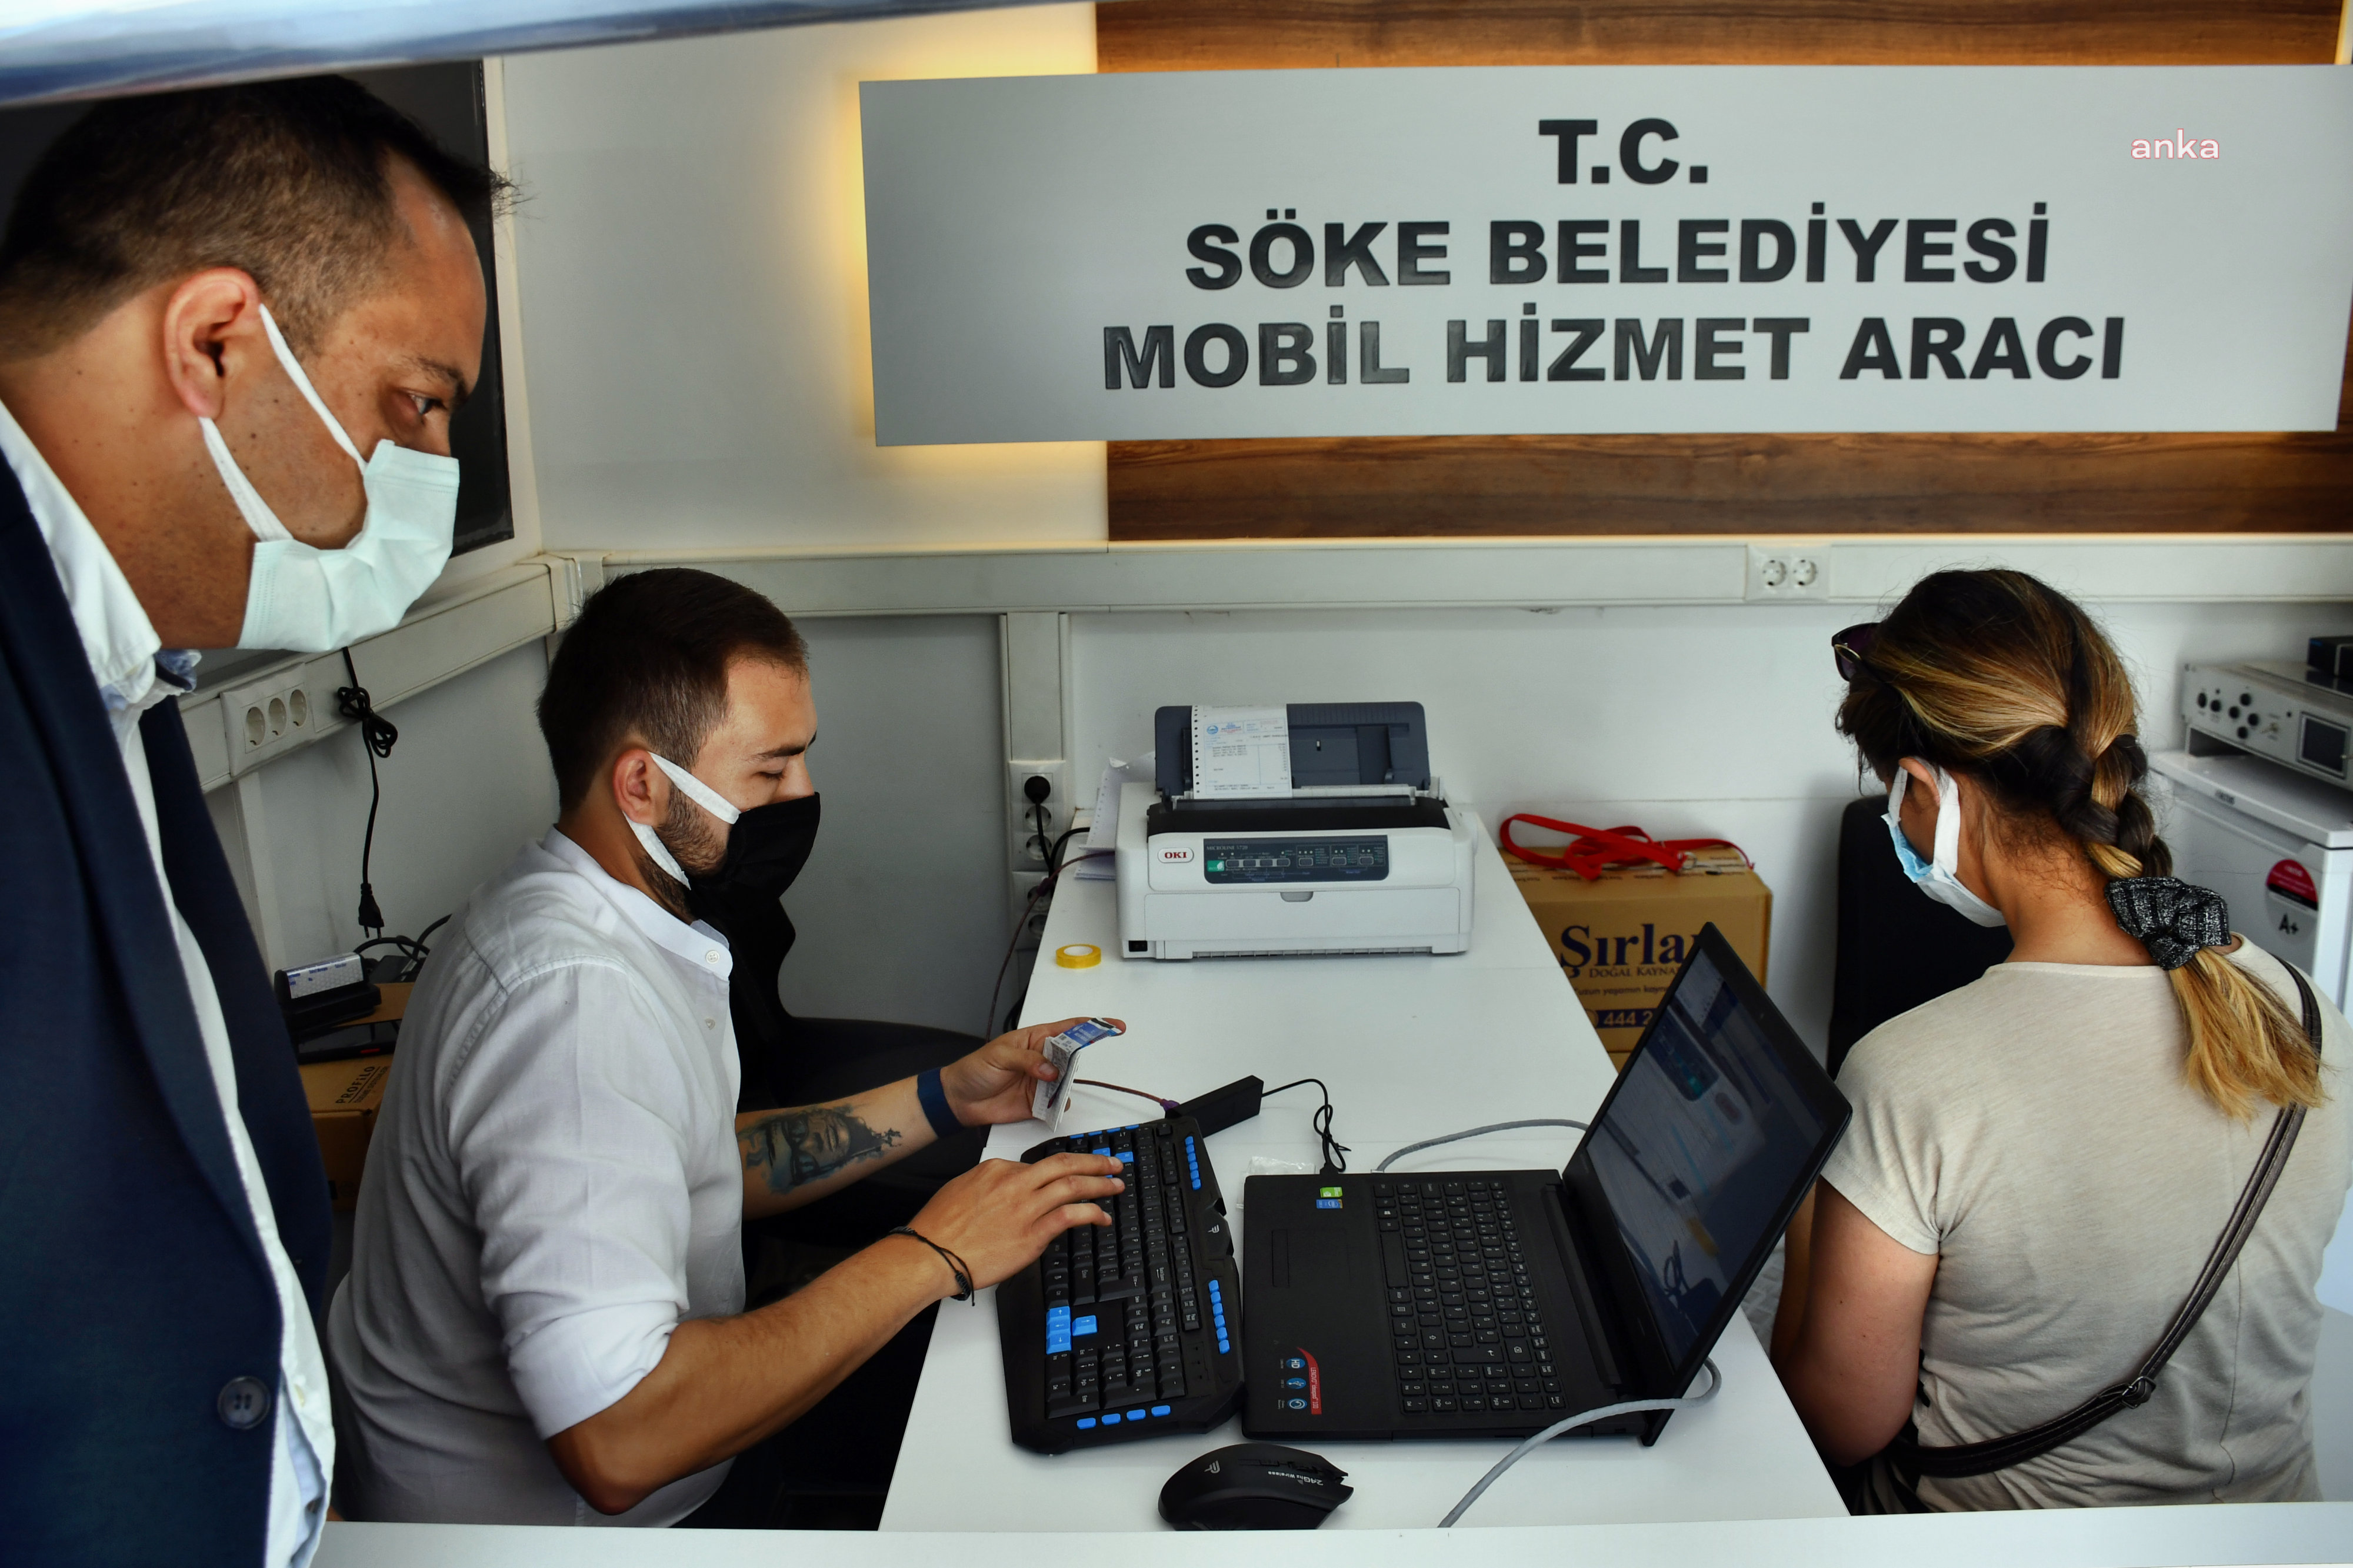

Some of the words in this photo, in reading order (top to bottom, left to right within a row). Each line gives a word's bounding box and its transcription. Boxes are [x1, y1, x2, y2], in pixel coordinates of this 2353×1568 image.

[1539, 119, 1708, 185] T.C.
[1185, 209, 1451, 291] SÖKE
[1490, 202, 2049, 285] BELEDİYESİ
[1103, 305, 1409, 390] MOBİL
[1447, 302, 1809, 383] HİZMET
[1839, 316, 2124, 380] ARACI
[2279, 912, 2299, 935] A+
[1561, 923, 1699, 979] Şırla
[1637, 966, 1680, 977] KAYNA
[1604, 1012, 1637, 1026] 444
[1291, 1359, 1301, 1369] HD
